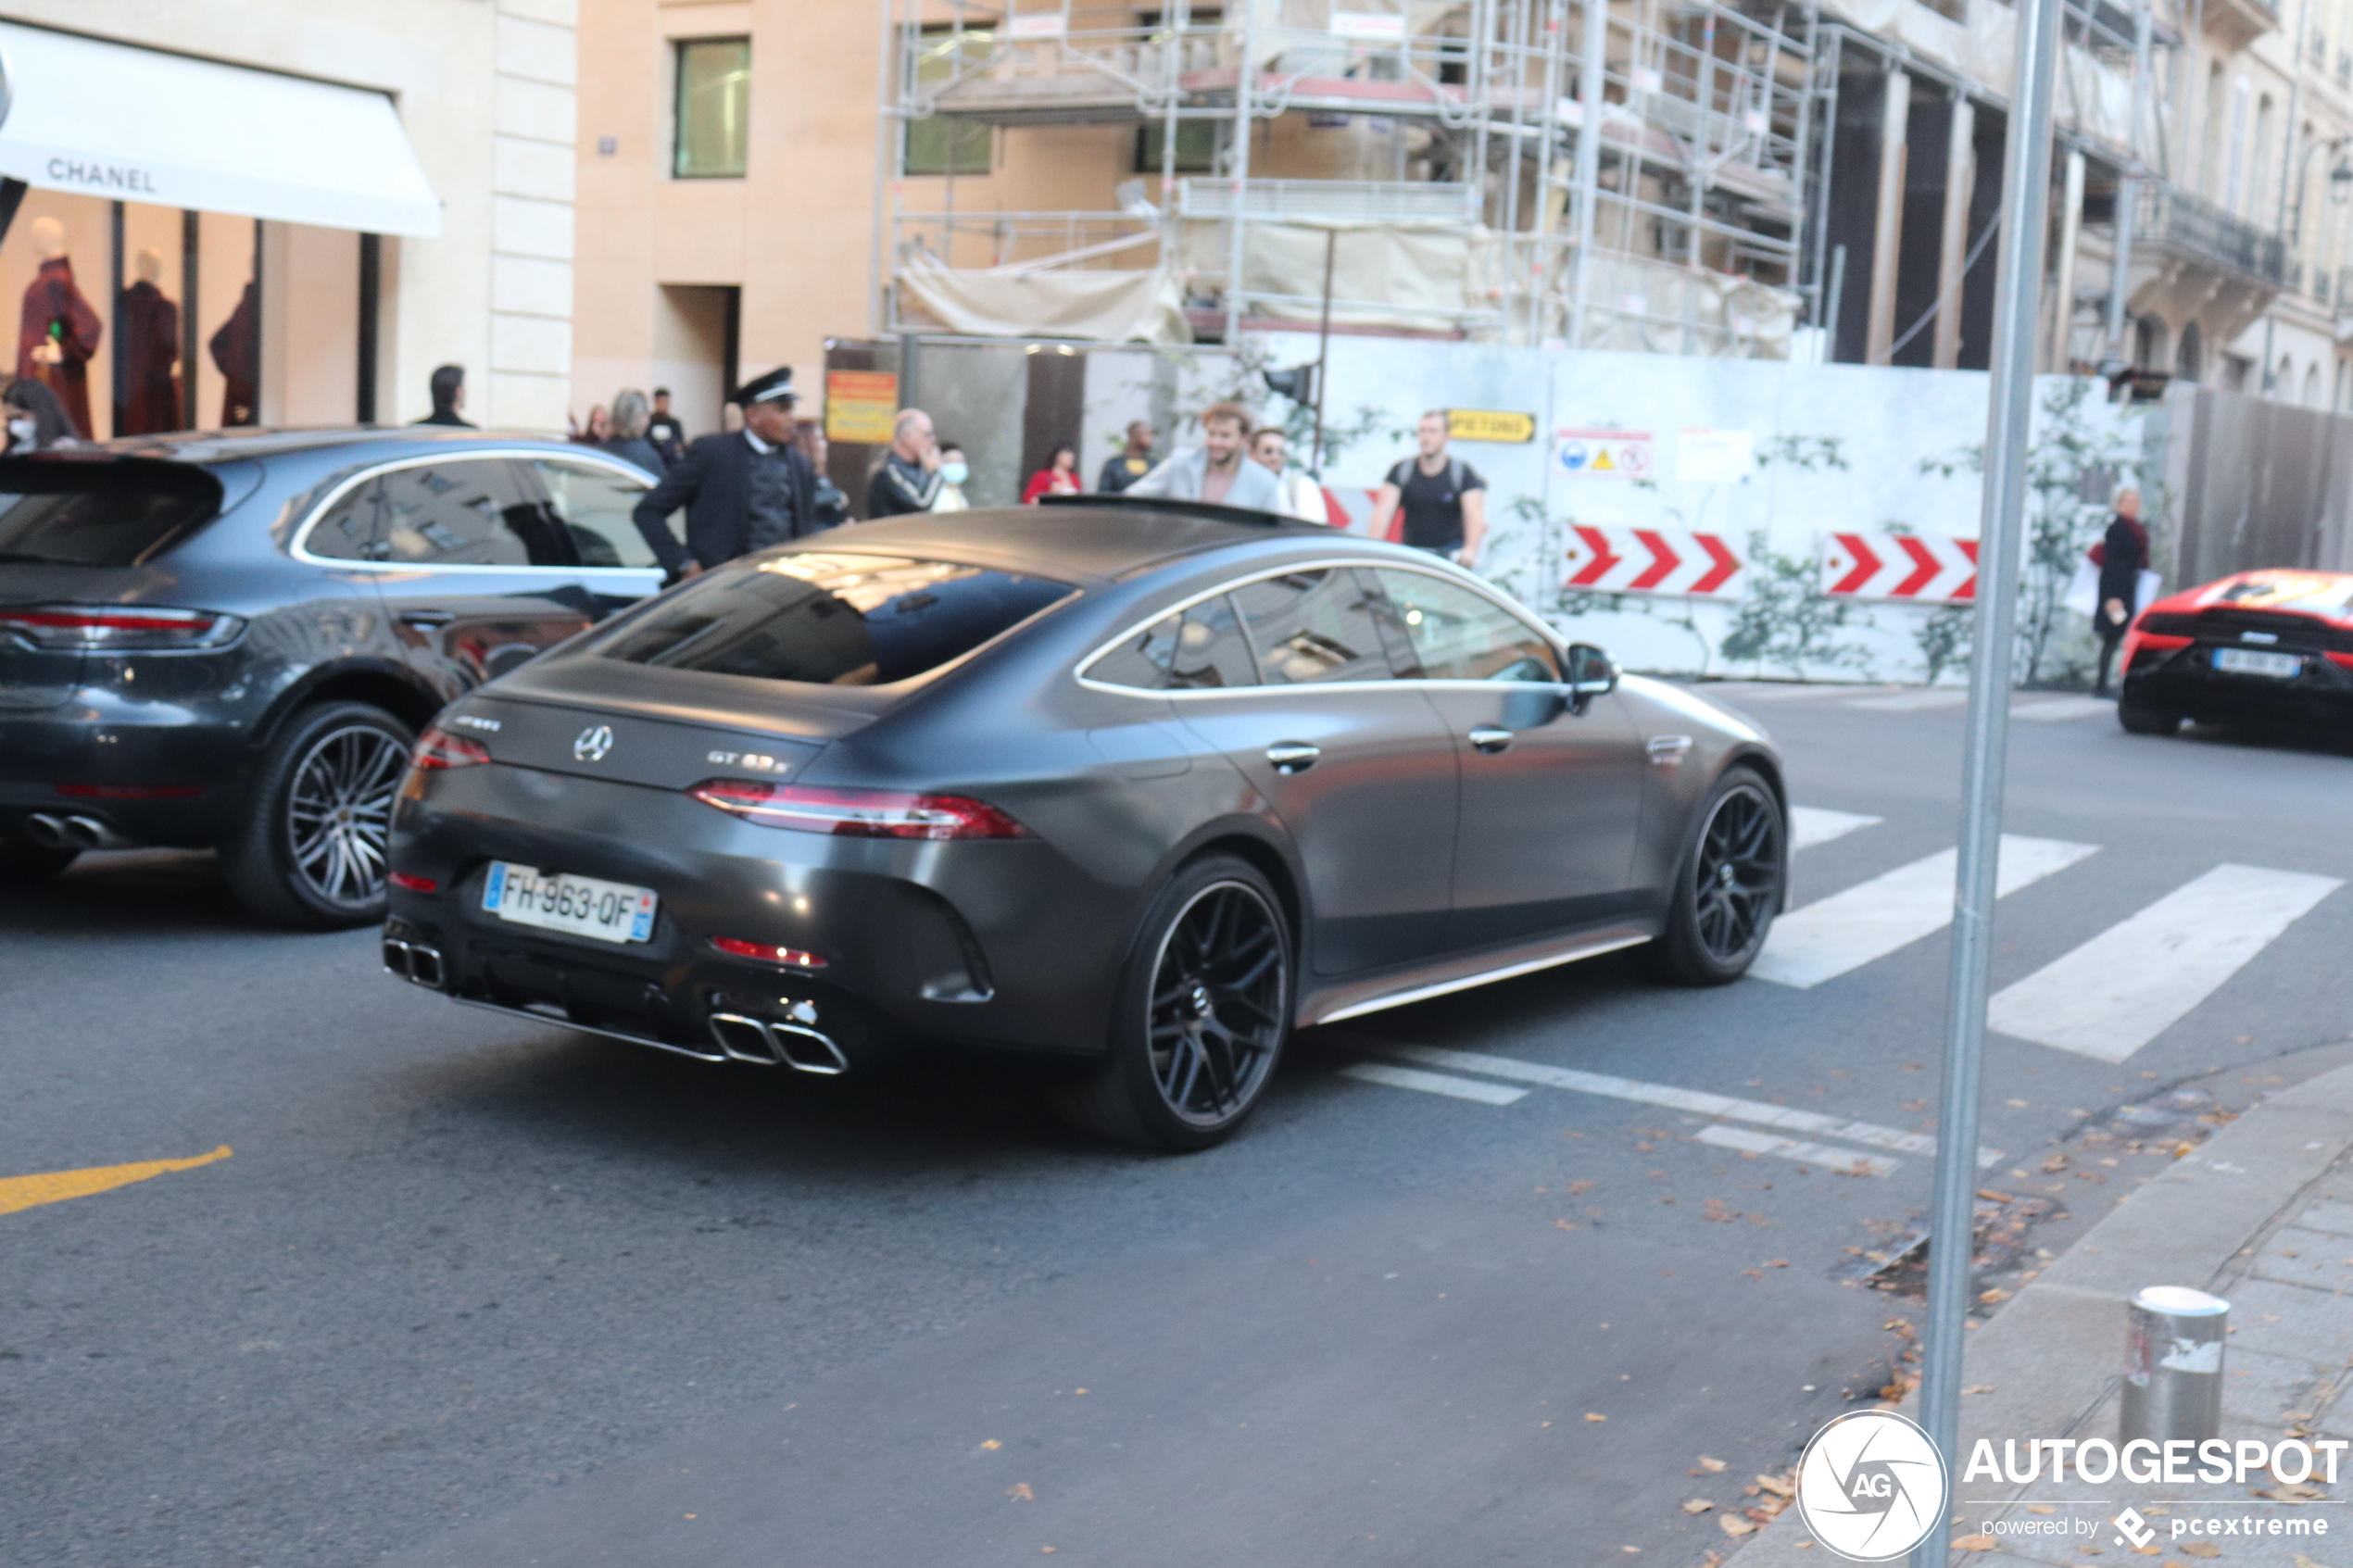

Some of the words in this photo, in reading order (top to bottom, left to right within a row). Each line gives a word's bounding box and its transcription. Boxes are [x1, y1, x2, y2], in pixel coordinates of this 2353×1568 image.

[47, 157, 156, 194] CHANEL
[707, 750, 739, 765] GT
[502, 872, 635, 927] FH-963-QF
